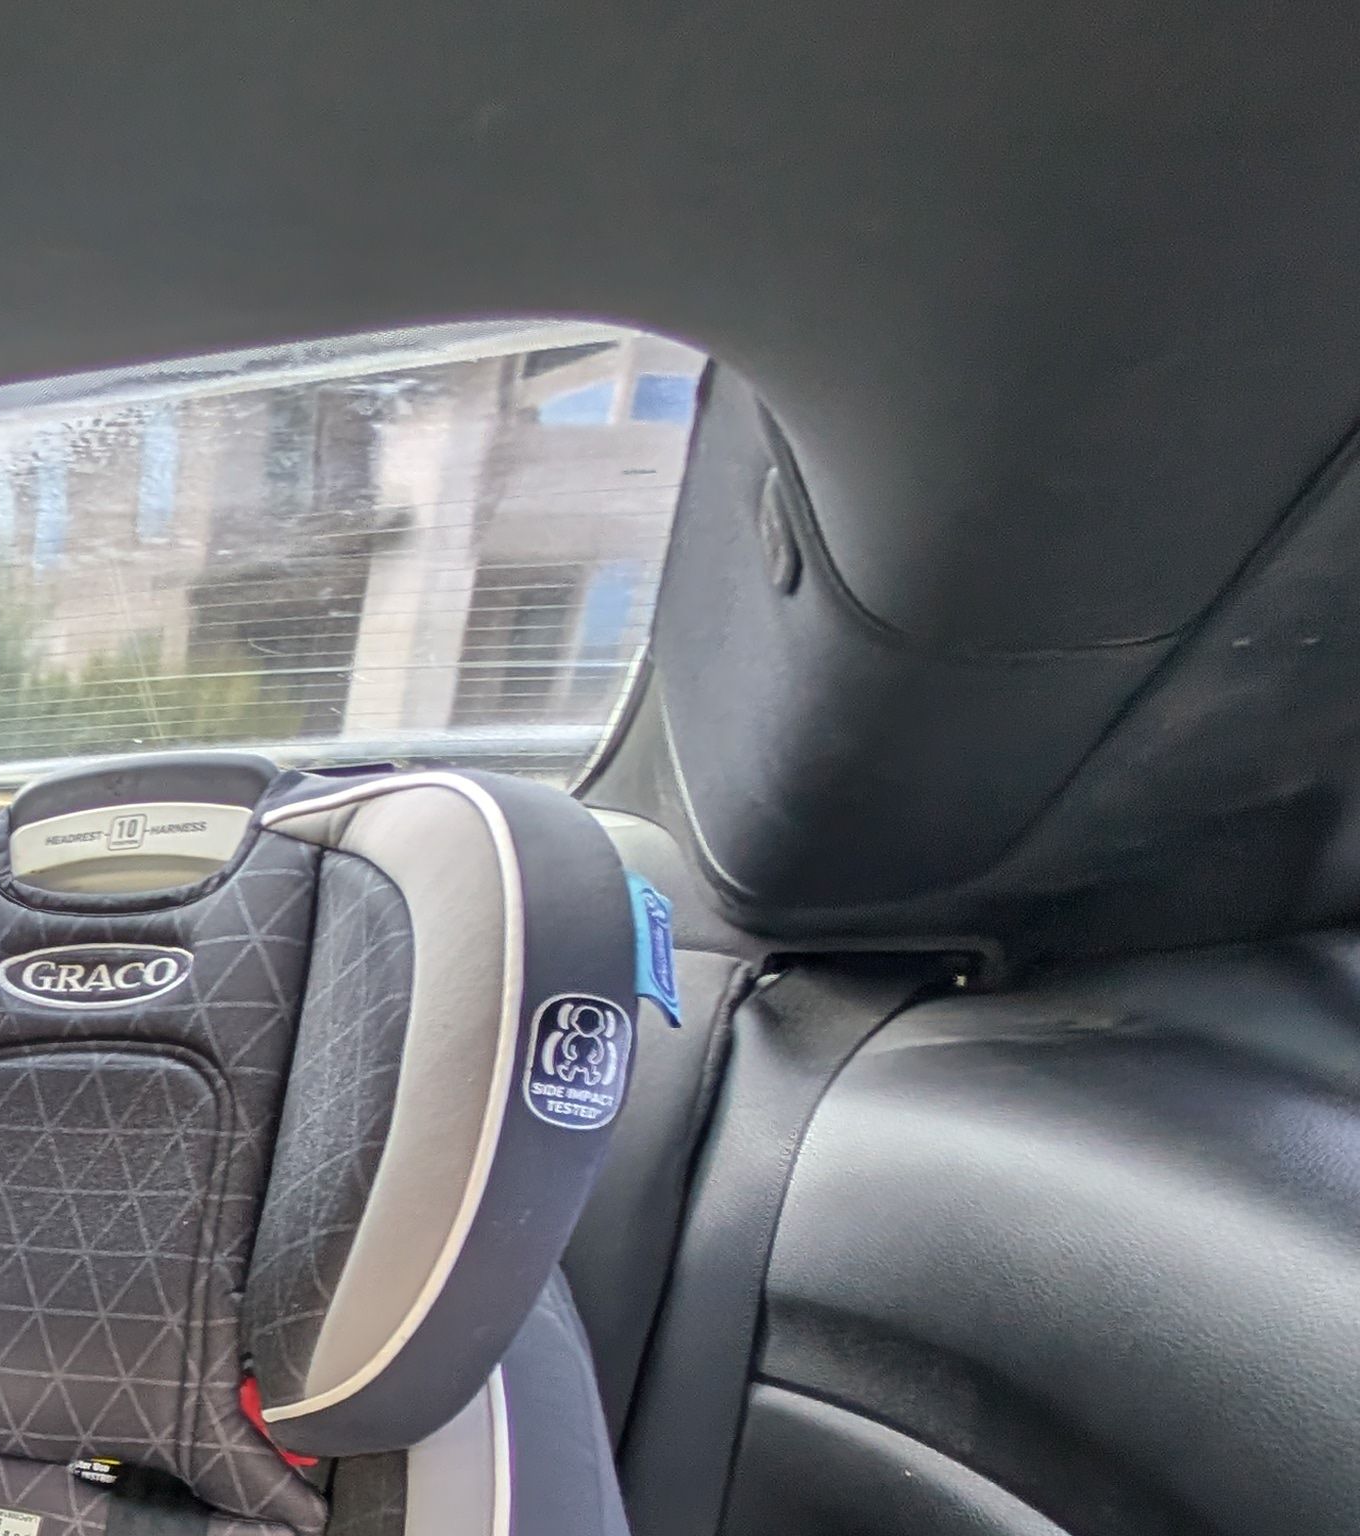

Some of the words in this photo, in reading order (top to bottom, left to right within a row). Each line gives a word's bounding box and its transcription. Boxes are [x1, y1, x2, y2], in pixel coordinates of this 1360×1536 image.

[45, 830, 102, 846] HEADREST
[117, 818, 138, 839] 10
[150, 821, 208, 835] HARNESS
[21, 957, 179, 993] GRACO
[531, 1082, 565, 1098] SIDE
[566, 1086, 615, 1106] IMPACT
[546, 1099, 602, 1119] TESTED
